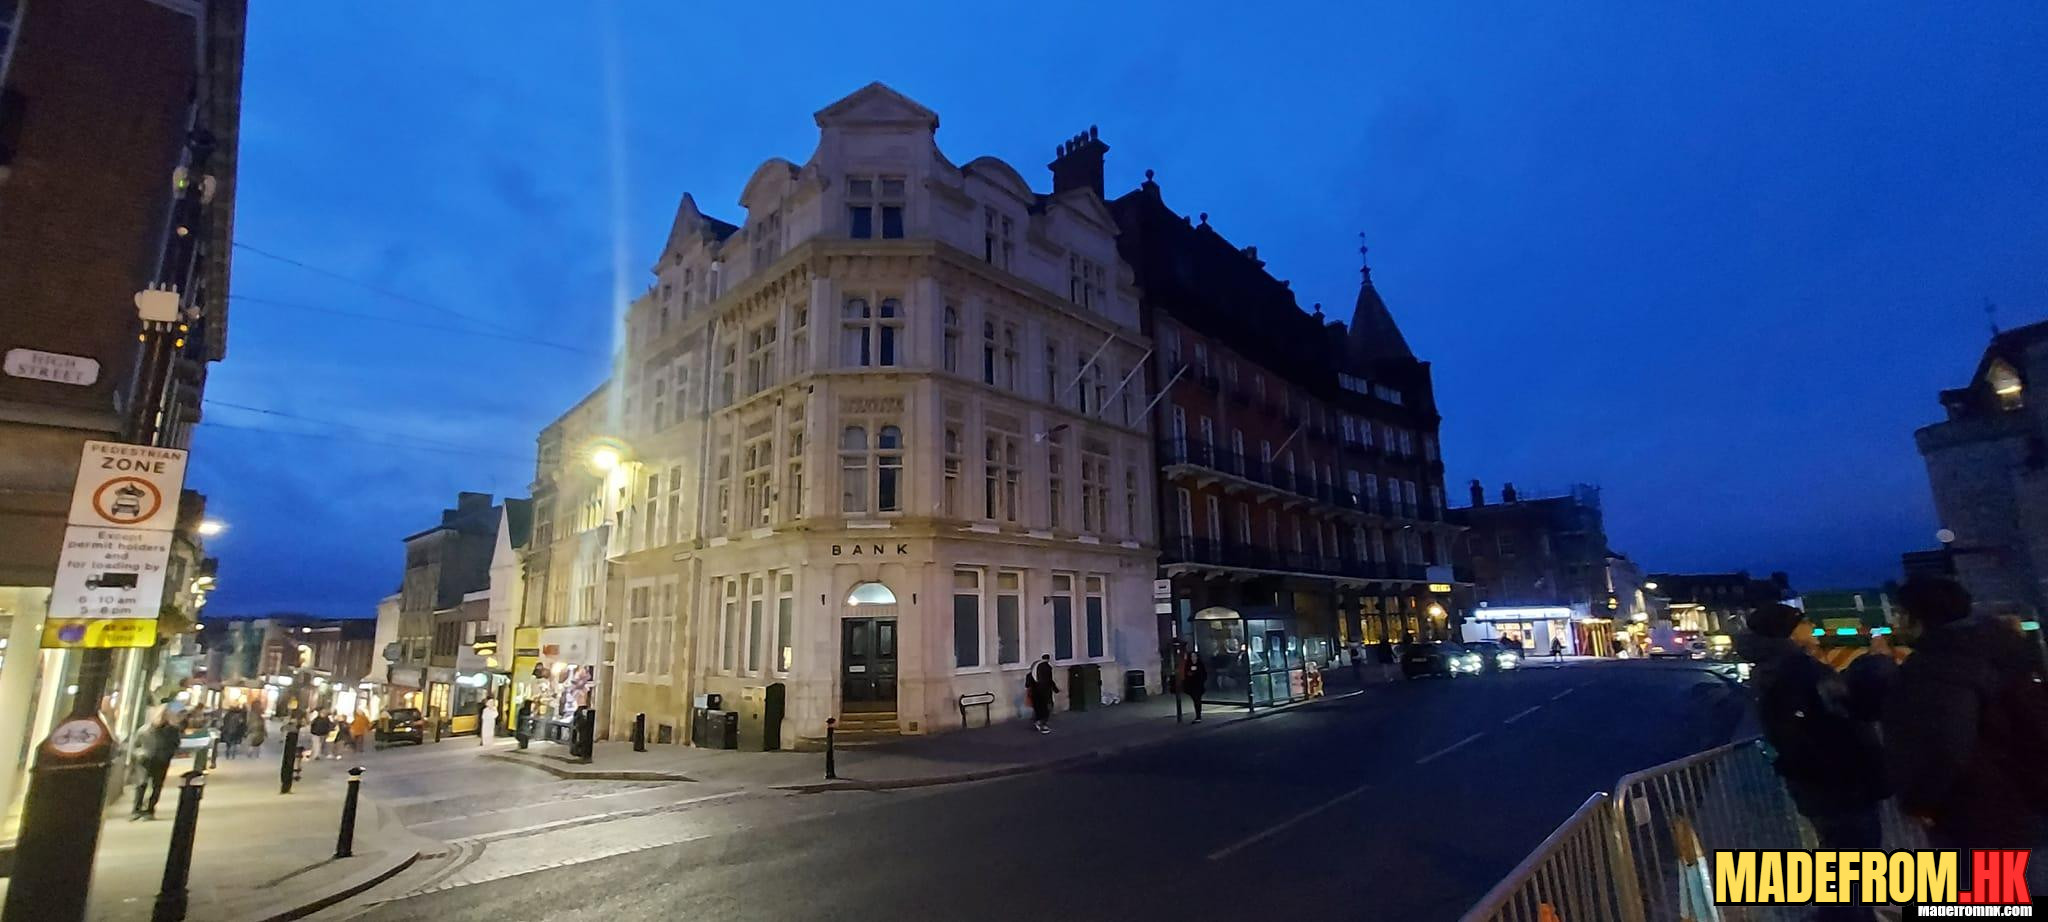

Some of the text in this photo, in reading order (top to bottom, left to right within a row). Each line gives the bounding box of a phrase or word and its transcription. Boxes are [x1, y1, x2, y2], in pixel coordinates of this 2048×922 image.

[91, 444, 181, 460] PEDESTRIAN
[101, 457, 165, 474] ZONE
[98, 531, 142, 541] Except
[68, 541, 166, 552] permit holders
[832, 544, 908, 556] BANK
[105, 552, 129, 560] and
[67, 560, 160, 572] for loading by
